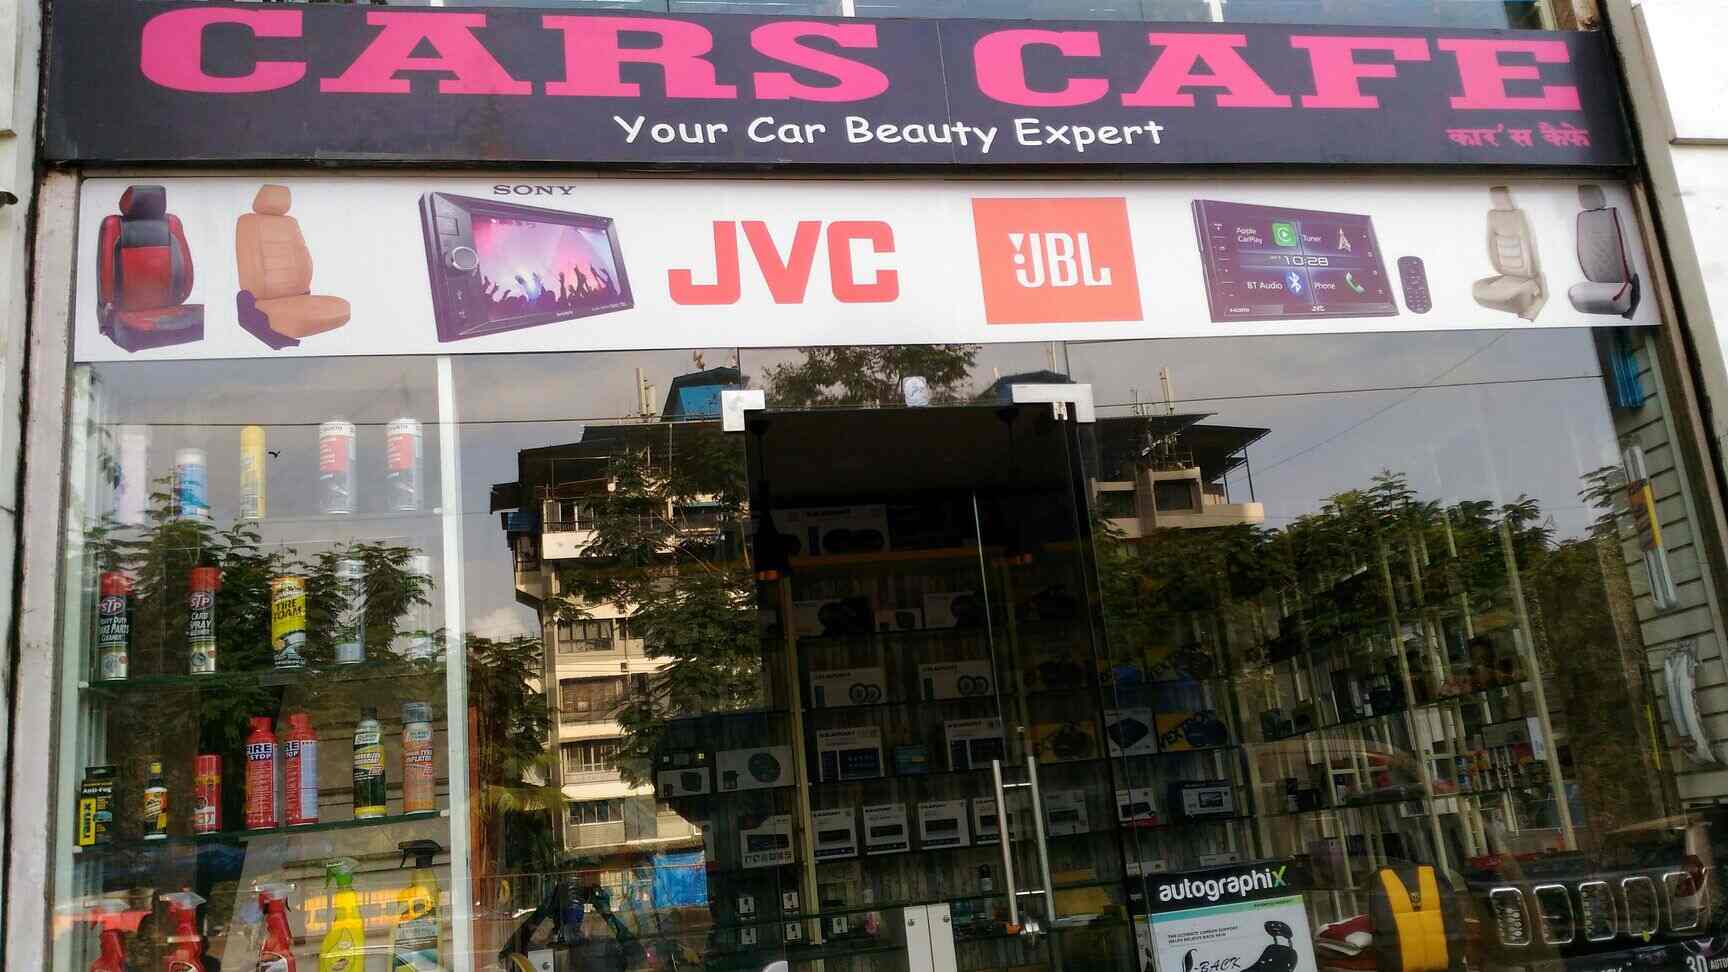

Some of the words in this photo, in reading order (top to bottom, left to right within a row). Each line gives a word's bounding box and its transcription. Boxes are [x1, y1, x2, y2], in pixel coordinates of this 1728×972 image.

[140, 8, 890, 103] CARS
[973, 27, 1581, 112] CAFE
[613, 115, 729, 144] Your
[747, 116, 826, 144] Car
[845, 115, 998, 154] Beauty
[1013, 117, 1164, 153] Expert
[493, 184, 577, 197] SONY
[669, 221, 899, 304] JVC
[1008, 229, 1113, 289] JBL
[1285, 255, 1329, 267] 10:28
[1260, 281, 1284, 290] Audio
